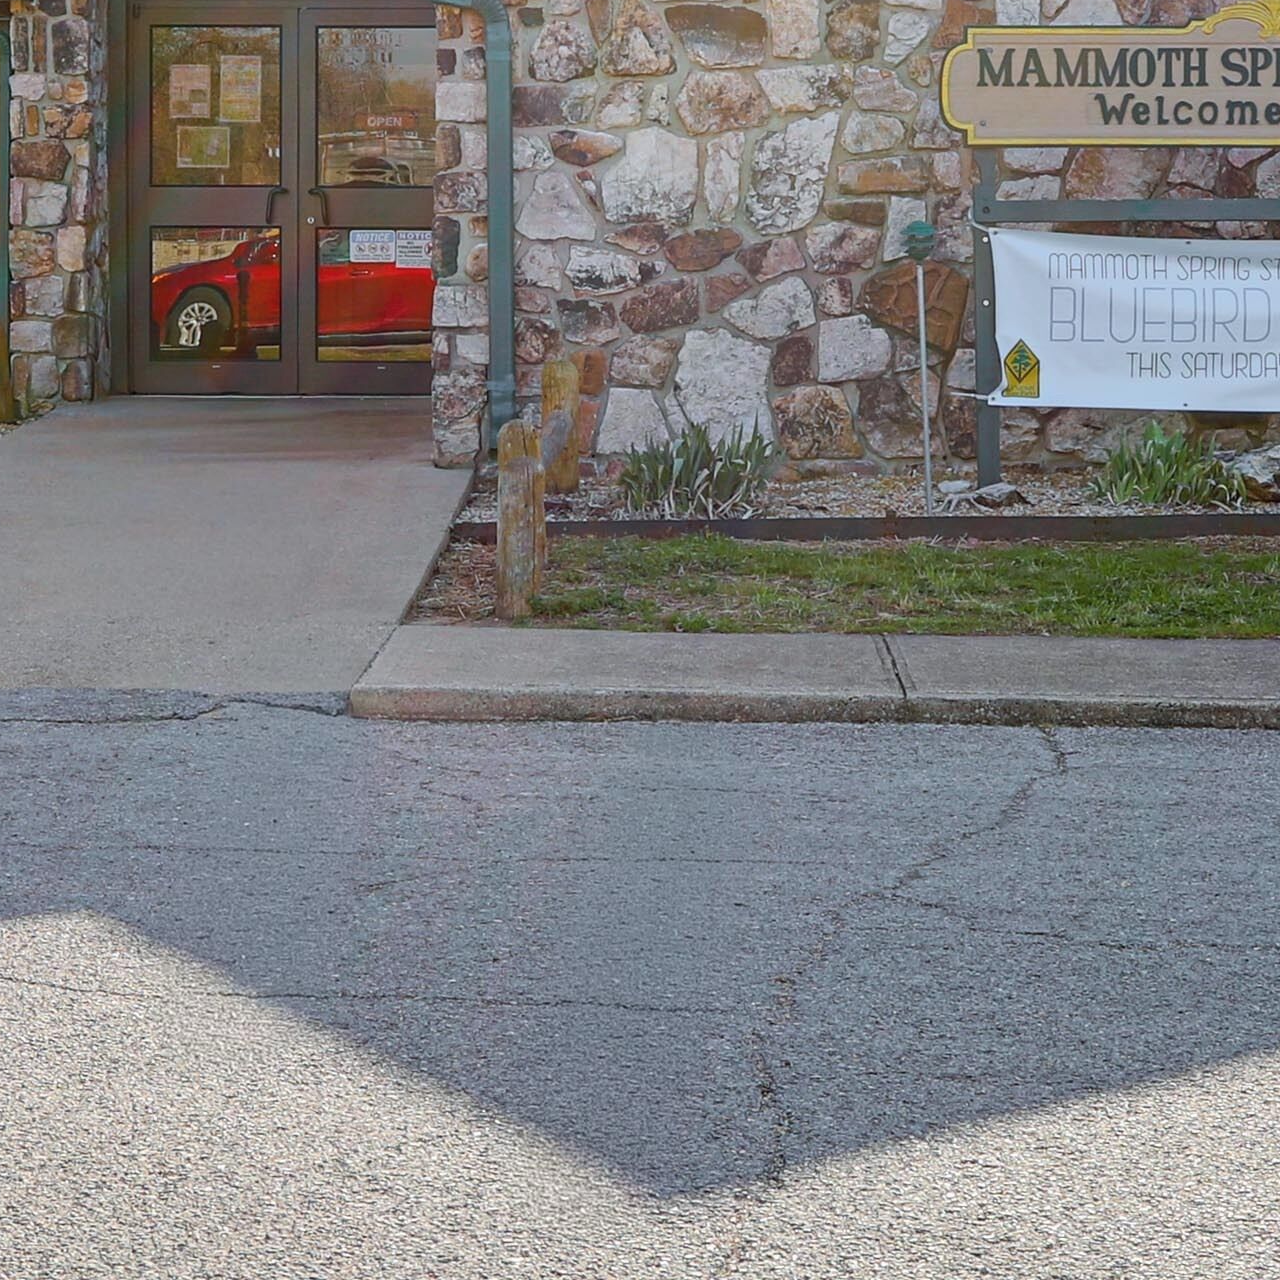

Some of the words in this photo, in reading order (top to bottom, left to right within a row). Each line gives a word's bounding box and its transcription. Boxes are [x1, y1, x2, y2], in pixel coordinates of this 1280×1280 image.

[976, 47, 1209, 88] MAMMOTH
[367, 116, 402, 127] OPEN
[355, 232, 391, 242] NOTICE
[399, 232, 432, 240] NOTIC
[1048, 252, 1168, 280] MAMMOTH
[1176, 255, 1251, 281] SPRING
[1049, 286, 1271, 344] BLUEBIRD
[1126, 351, 1172, 380] THIS
